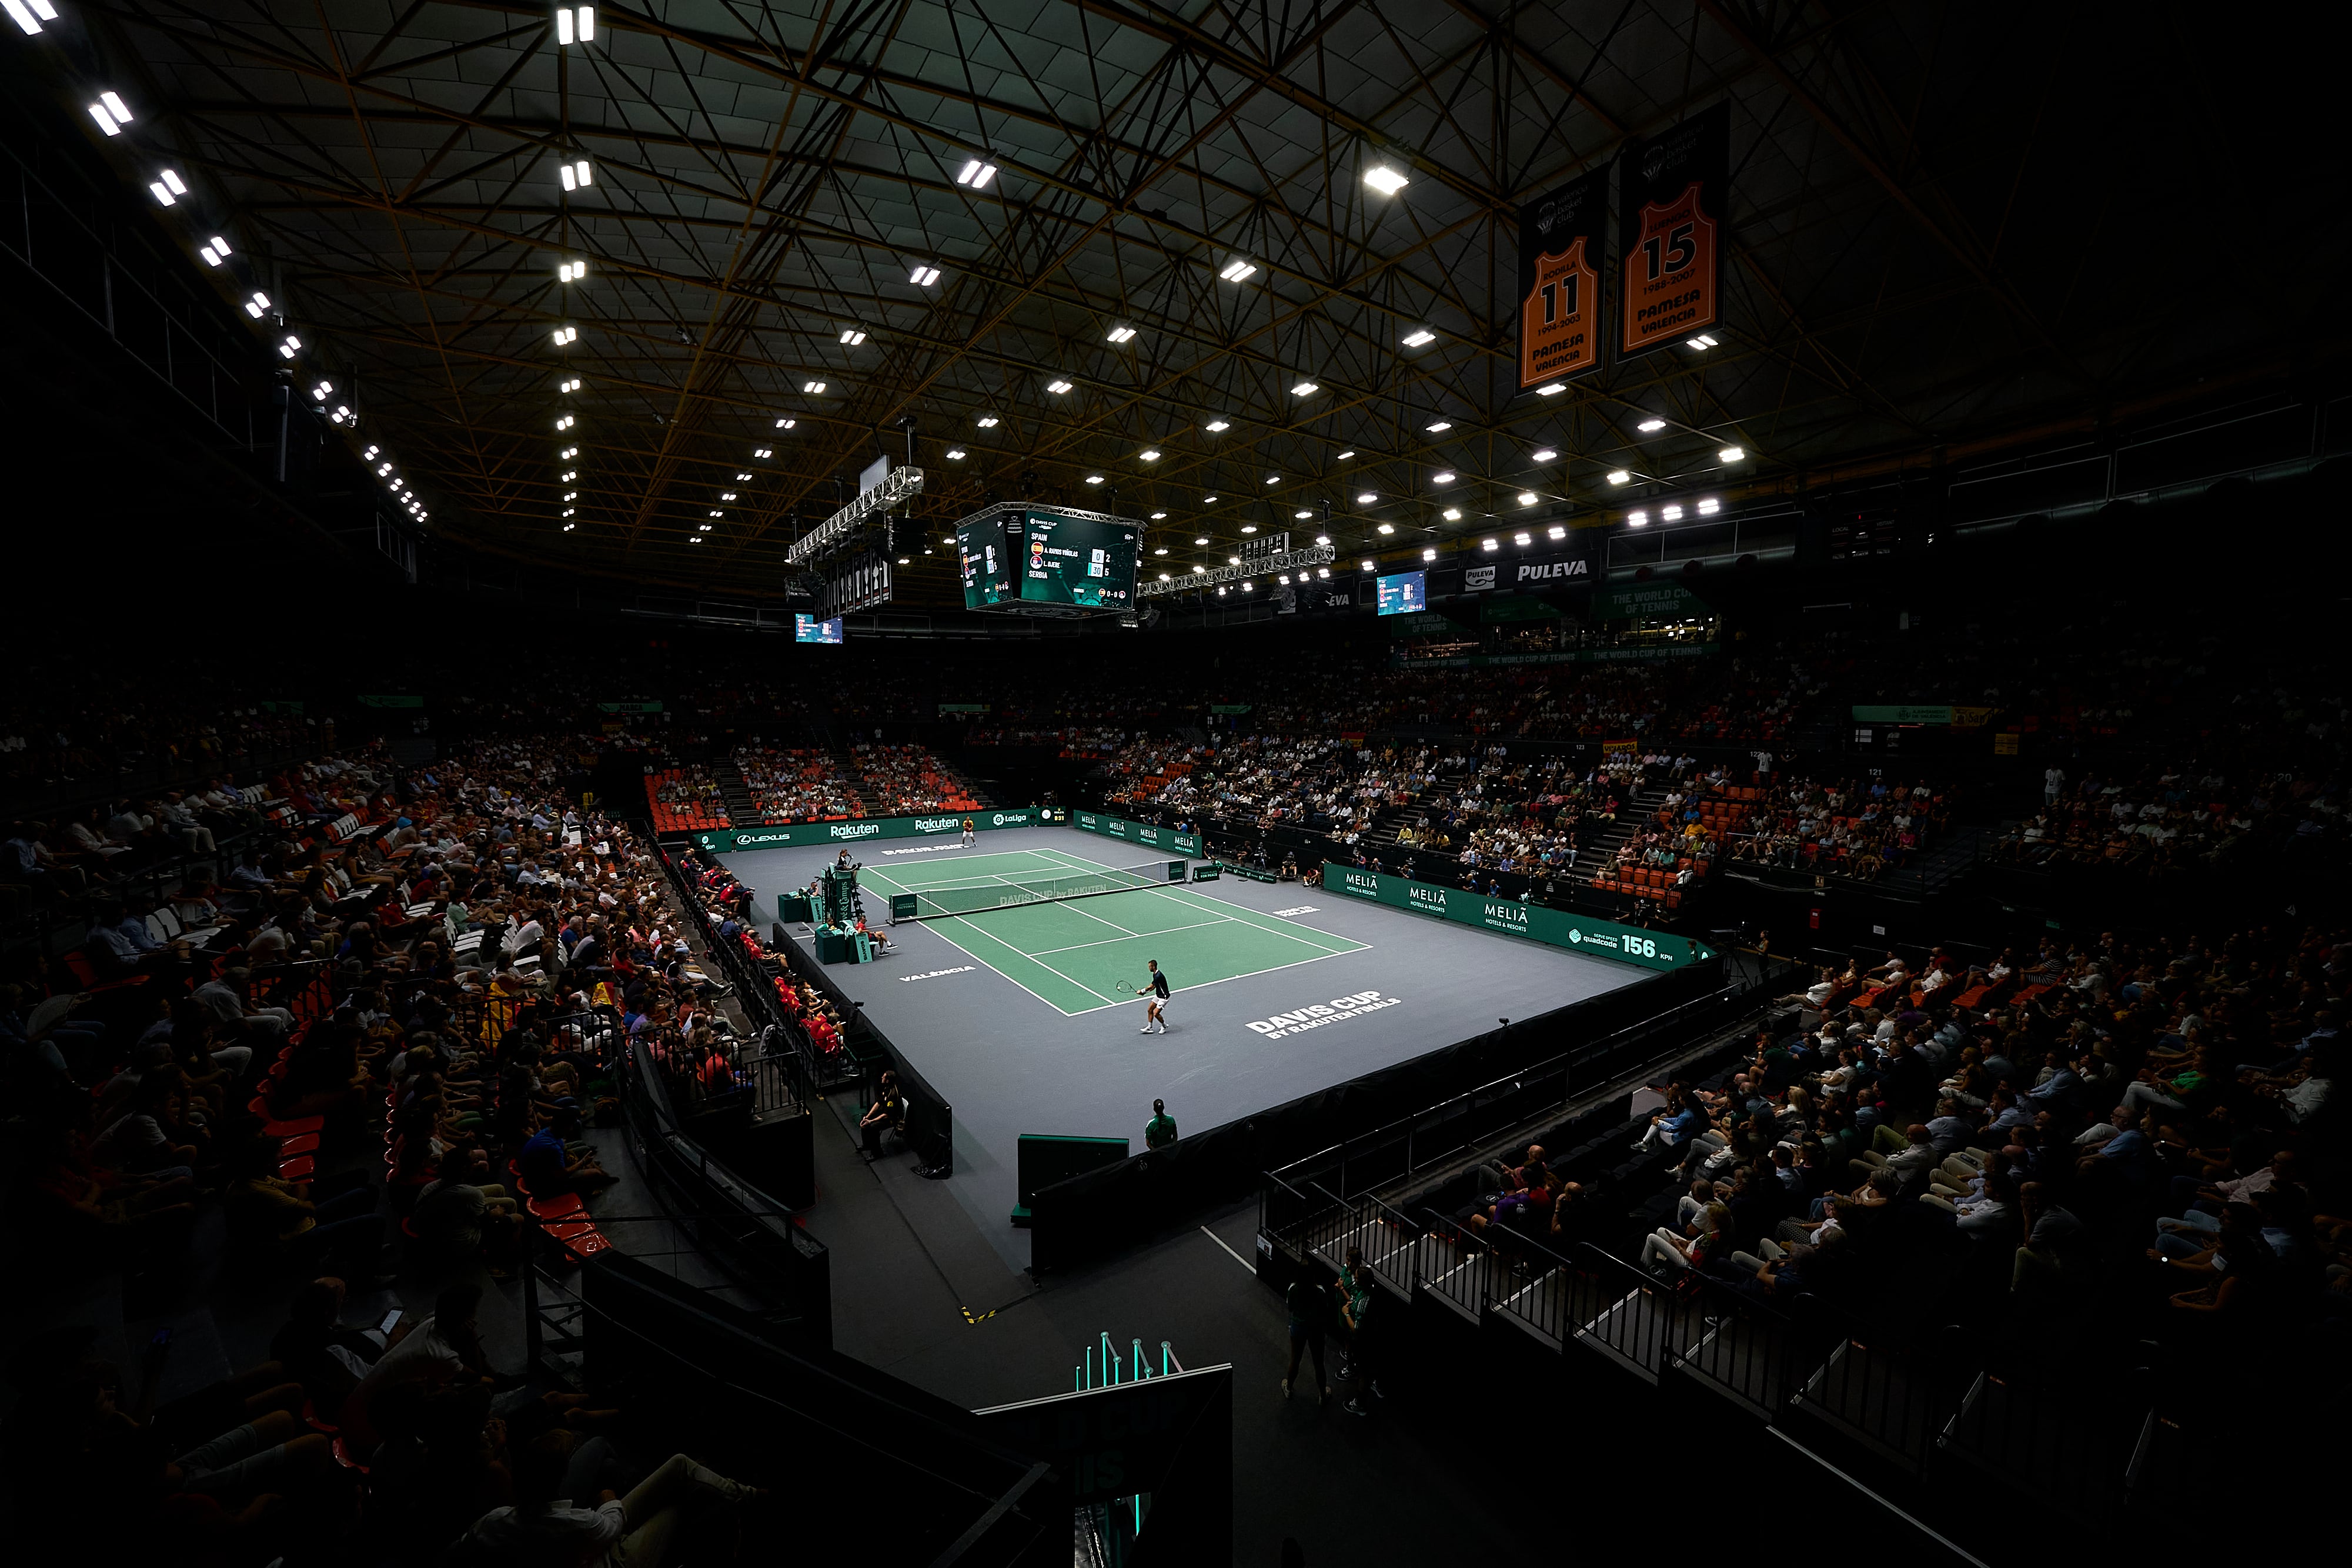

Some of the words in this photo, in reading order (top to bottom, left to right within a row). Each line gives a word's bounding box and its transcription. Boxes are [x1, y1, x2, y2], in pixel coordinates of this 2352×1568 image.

[1650, 209, 1690, 232] LUENGO
[1643, 221, 1696, 282] 15
[1544, 262, 1576, 280] RODILLA
[1643, 268, 1696, 295] 1988-2007
[1541, 272, 1579, 325] 11
[1638, 289, 1700, 322] PAMESA
[1538, 315, 1581, 336] 1994-2003
[1641, 307, 1696, 335] VALENCIA
[1532, 333, 1584, 360] PAMESA
[1536, 350, 1580, 372] VALENCIA
[1031, 533, 1048, 541] SPAIN
[1049, 547, 1062, 556] RAMOS
[1062, 549, 1078, 557] VIÑOLAS
[1096, 553, 1100, 561] 0
[1105, 554, 1111, 563] 2
[1029, 570, 1048, 579] SERBIA
[1467, 570, 1494, 579] PULEVA
[1517, 560, 1589, 582] PULEVA
[1612, 594, 1632, 605] THE
[1634, 589, 1671, 603] WORLD
[1625, 604, 1638, 614] OF
[1641, 600, 1681, 612] TENNIS
[1417, 614, 1441, 624] WORLD
[1412, 625, 1421, 633] OF
[1422, 622, 1447, 632] TENNIS
[1501, 656, 1524, 664] WORLD
[1549, 653, 1576, 661] TENNIS
[1609, 650, 1638, 659] WORLD
[1639, 649, 1656, 658] CUP
[1658, 648, 1670, 657] OF
[1671, 647, 1702, 657] TENNIS
[915, 817, 958, 831] Rakuten
[1005, 814, 1027, 823] LaLiga
[752, 834, 790, 842] LEXUS
[831, 824, 879, 837] Rakuten
[1000, 894, 1031, 905] DAVIS
[1068, 884, 1107, 896] RAKUTEN
[1429, 904, 1445, 913] RESORTS
[1485, 918, 1501, 927] HOTELS
[1507, 922, 1526, 932] RESORTS
[1583, 936, 1617, 948] quadcode
[1622, 934, 1656, 958] 156
[1660, 953, 1673, 961] KPH
[1245, 1005, 1335, 1034] DAVIS
[1329, 991, 1381, 1009] CUP
[1265, 1029, 1289, 1039] BY
[1287, 1011, 1357, 1034] RAKUTEN
[1353, 998, 1402, 1015] FINALS
